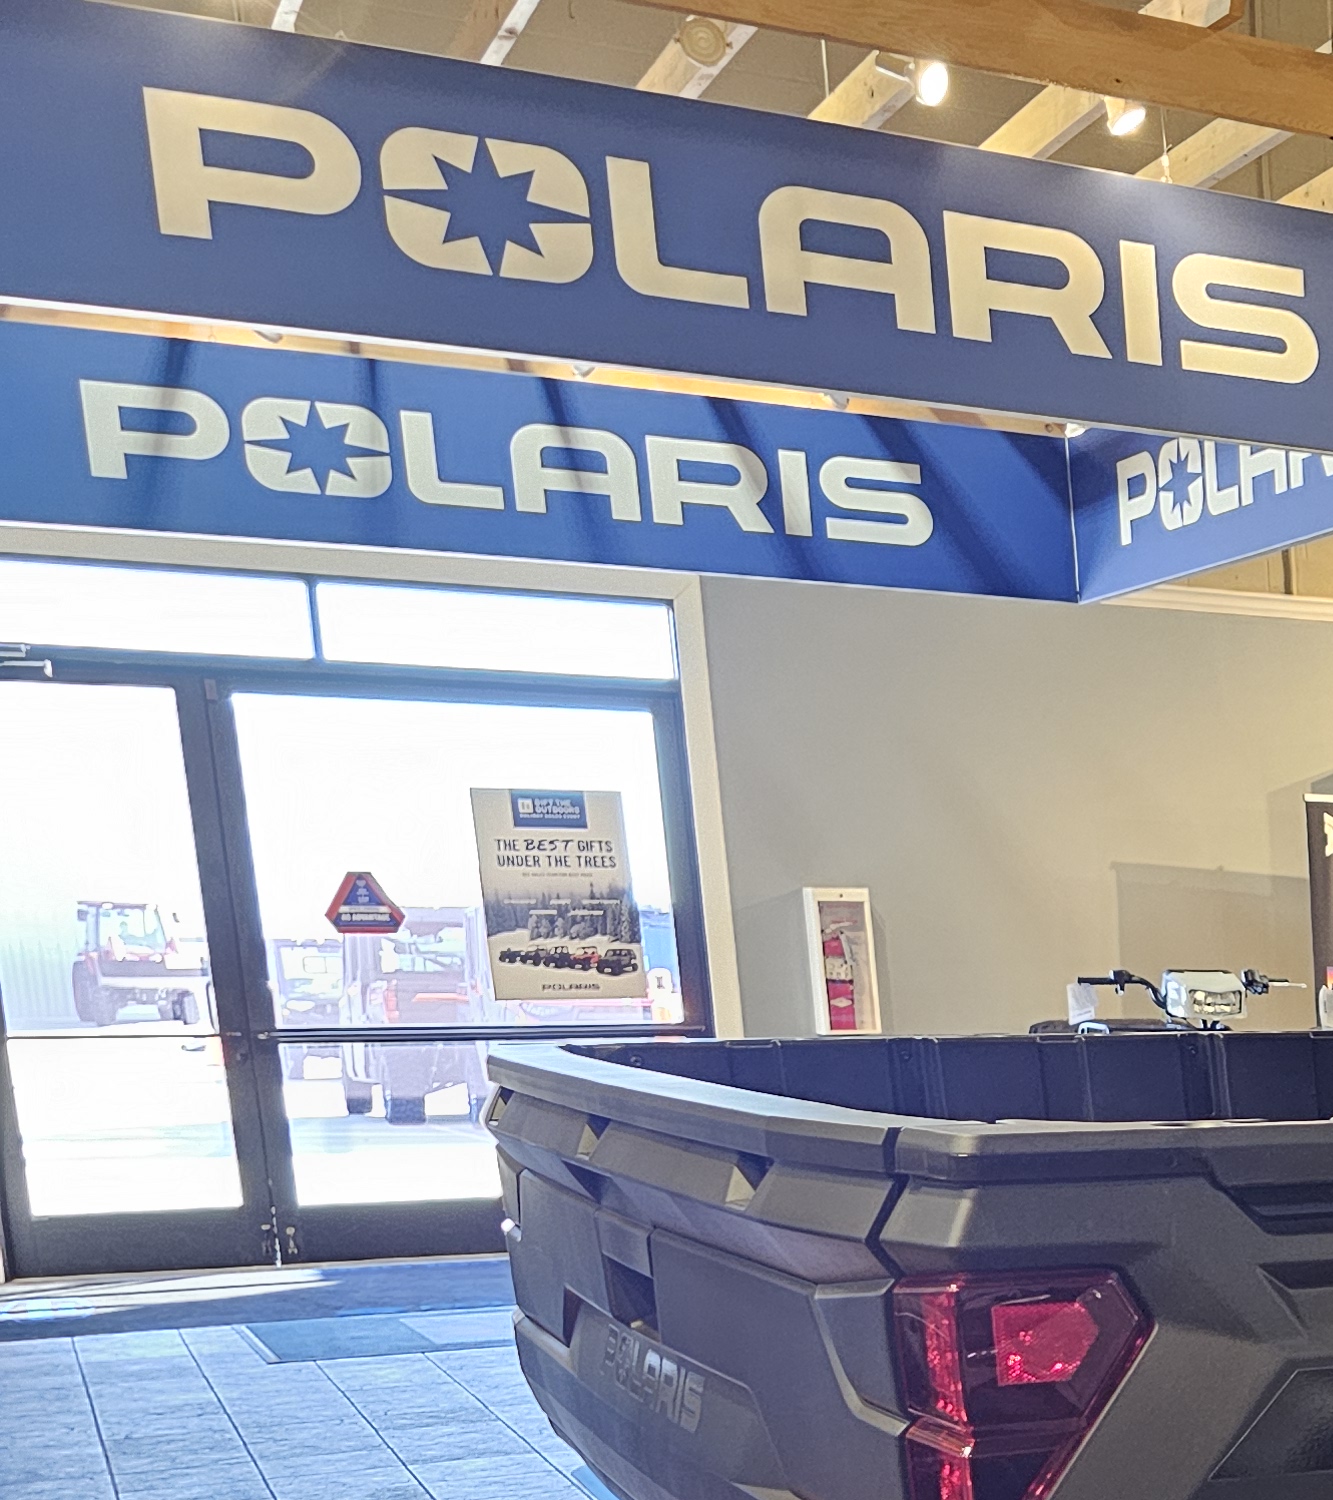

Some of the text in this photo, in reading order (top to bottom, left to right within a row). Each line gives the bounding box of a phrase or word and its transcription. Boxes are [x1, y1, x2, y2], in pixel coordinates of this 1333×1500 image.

[142, 86, 1320, 384] POLARIS
[79, 378, 934, 547] POLARIS
[496, 839, 613, 852] THE BEST GIFTS
[497, 855, 617, 868] UNDER THE TREES
